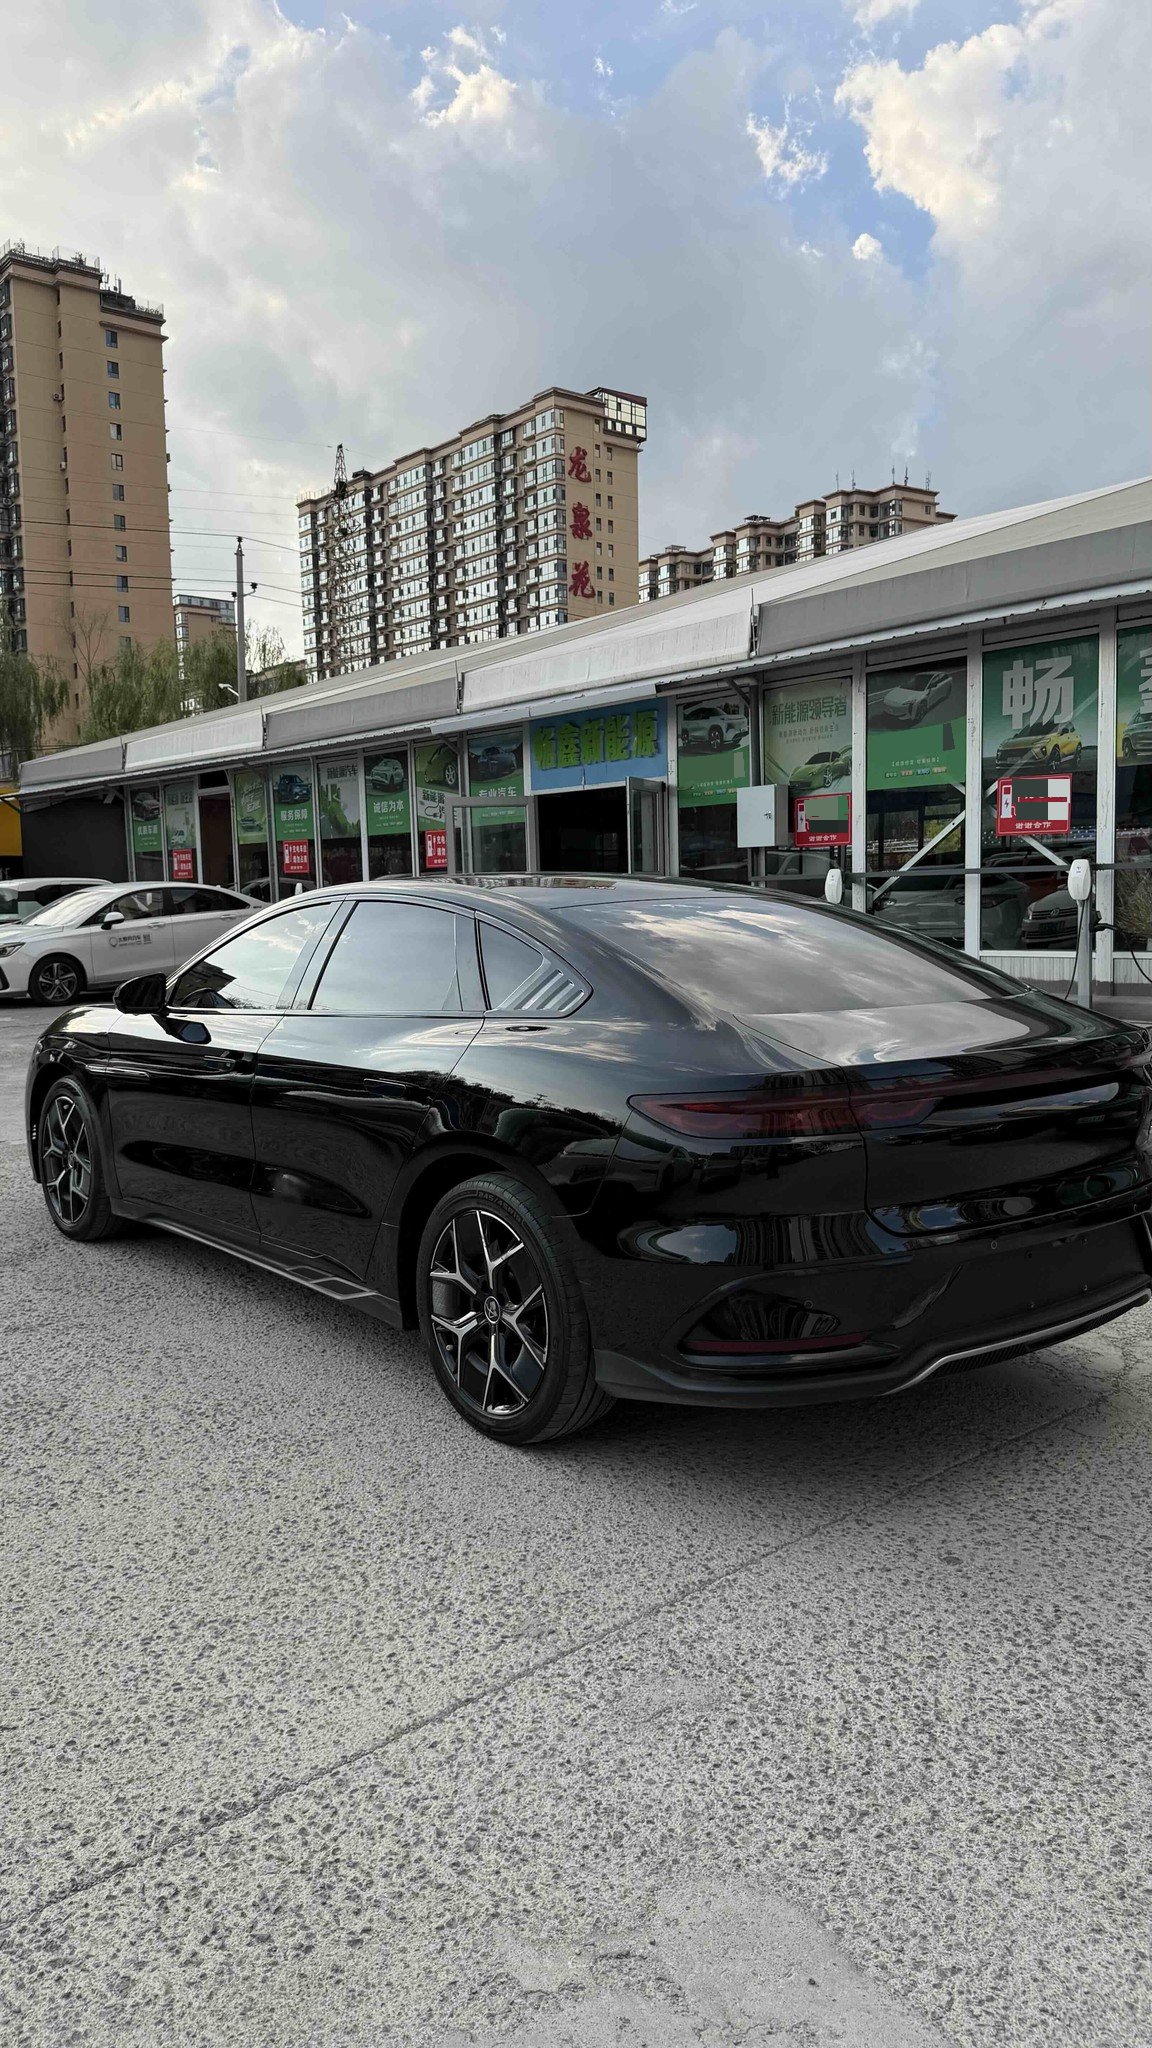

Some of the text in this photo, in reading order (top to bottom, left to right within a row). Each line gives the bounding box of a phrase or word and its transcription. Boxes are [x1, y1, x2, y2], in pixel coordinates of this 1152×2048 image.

[1002, 655, 1075, 730] 畅
[770, 695, 847, 726] 新能源领导者
[534, 710, 659, 770] 畅鑫新能源
[280, 808, 308, 822] 服务保障
[373, 799, 405, 814] 诚信为本
[1015, 821, 1052, 830] 谢谢合作
